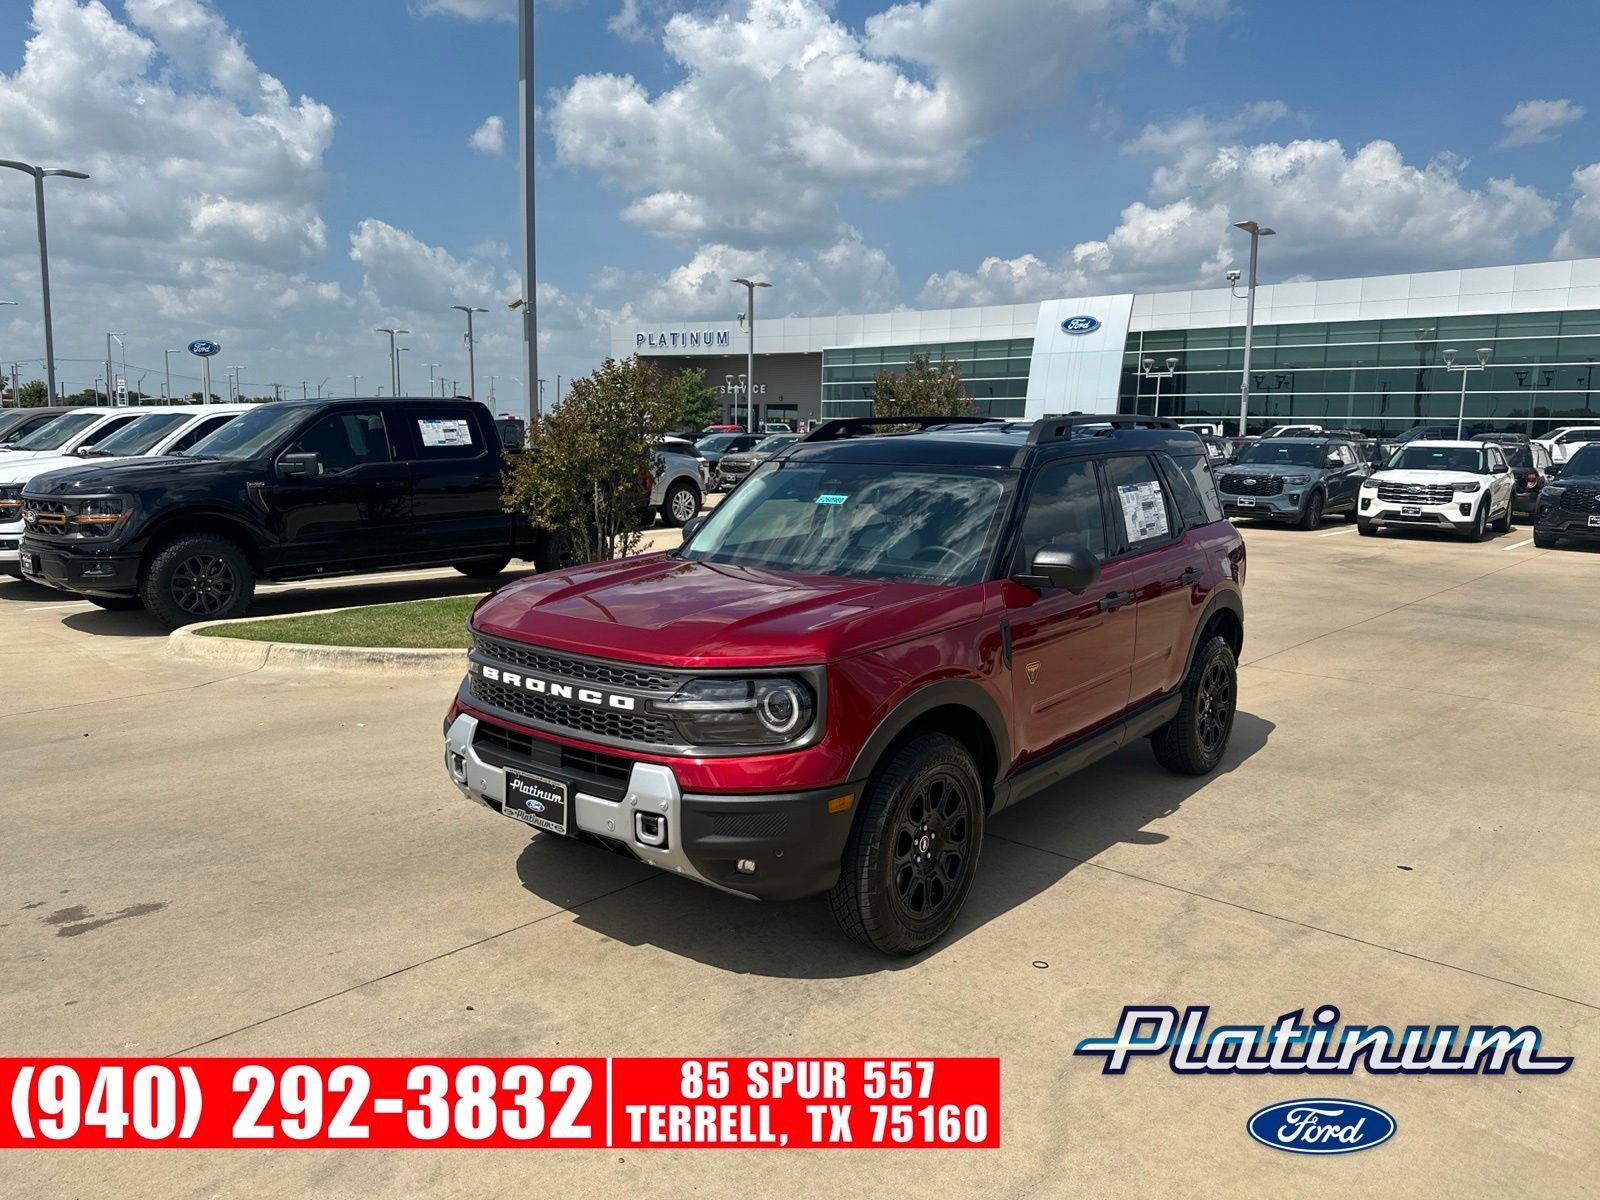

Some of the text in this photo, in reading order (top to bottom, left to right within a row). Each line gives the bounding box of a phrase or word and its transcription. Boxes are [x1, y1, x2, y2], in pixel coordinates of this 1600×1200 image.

[636, 331, 730, 348] PLATINUM
[482, 665, 635, 711] BRONCO
[509, 778, 565, 804] Platinum
[516, 810, 554, 830] Platinum
